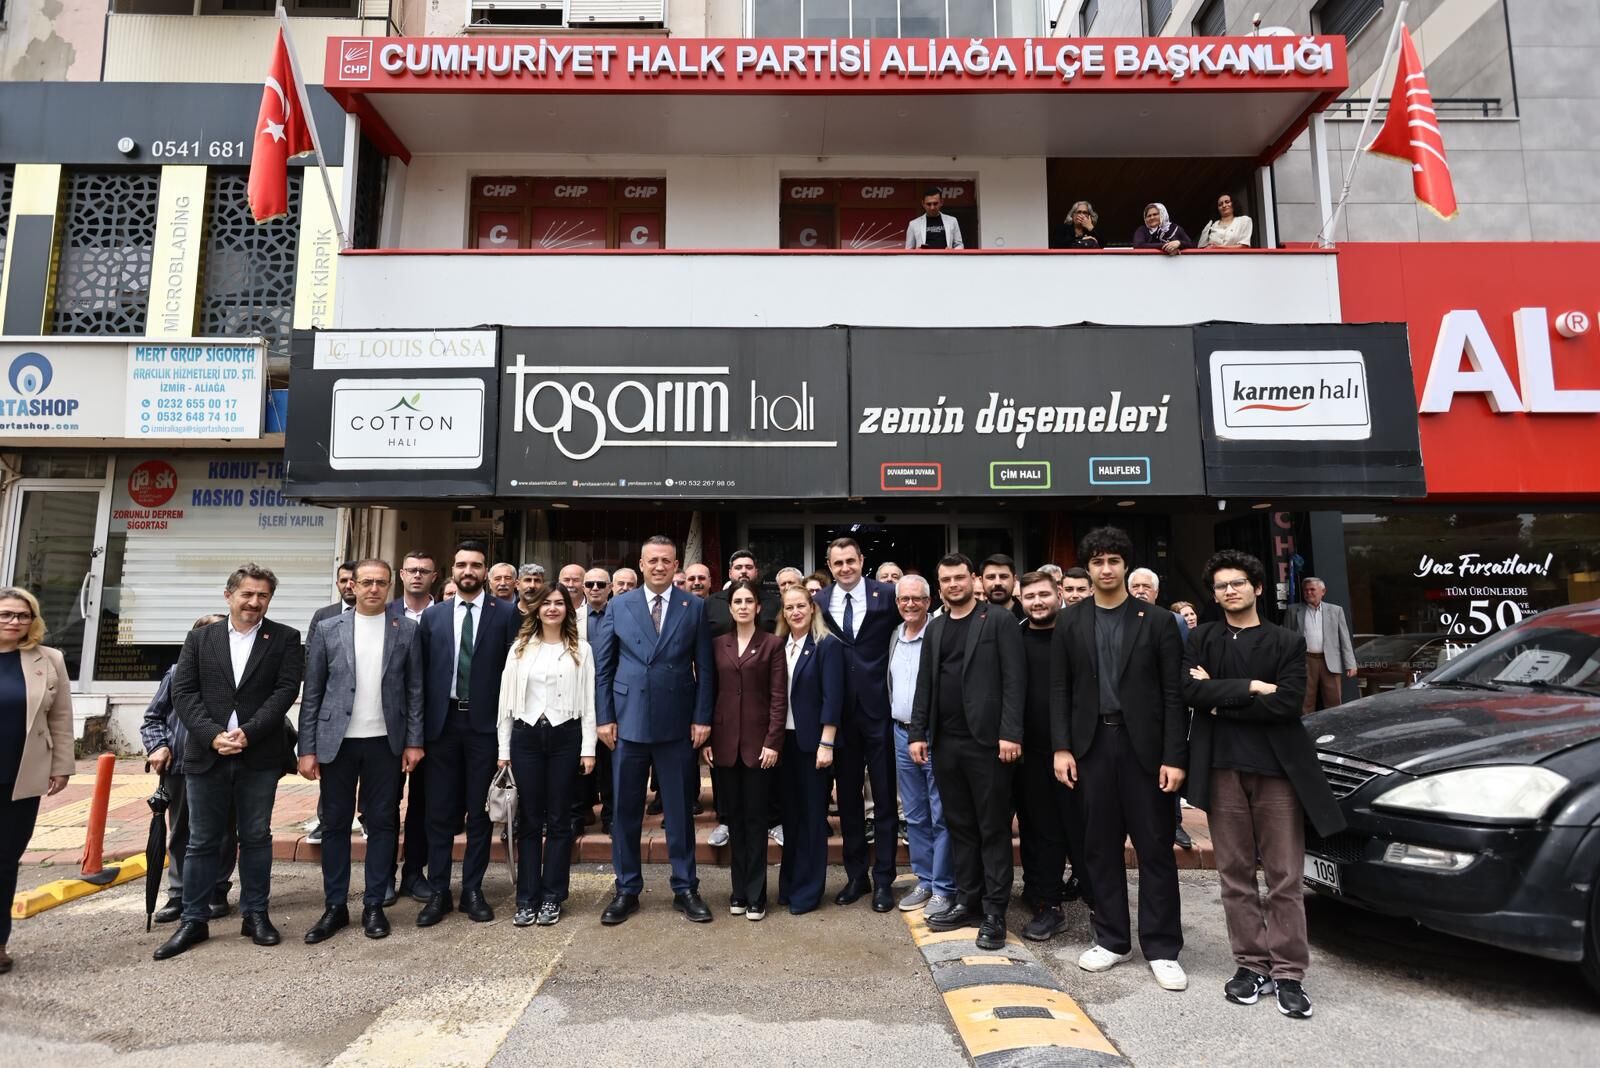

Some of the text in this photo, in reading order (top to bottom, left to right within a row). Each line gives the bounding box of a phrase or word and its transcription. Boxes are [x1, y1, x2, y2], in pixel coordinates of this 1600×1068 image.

[379, 37, 1333, 80] CUMHURİYET HALK PARTİSİ ALİAĞA İLÇE BAŞKANLIĞI
[343, 64, 367, 74] CHP
[151, 140, 244, 157] 0541 681
[483, 185, 517, 197] CHP
[554, 185, 588, 198] CHP
[624, 186, 657, 198] CHP
[791, 186, 825, 199] CHP
[861, 186, 895, 199] CHP
[939, 187, 964, 199] HP
[489, 225, 508, 244] C
[630, 226, 649, 245] C
[162, 195, 190, 332] MİCROBLADİNG
[311, 229, 332, 290] KİRPİK
[135, 344, 255, 363] MERT GRUP SİGORTA
[360, 338, 423, 358] LOUIS
[428, 338, 486, 358] CASA
[133, 367, 171, 380] ARACILIK
[173, 366, 221, 380] HİZMETLERİ
[223, 368, 240, 379] LTD.
[160, 381, 186, 392] İZMİR
[195, 381, 226, 393] ALİAĞA
[1233, 378, 1359, 401] karmen halı
[157, 398, 237, 409] 0232 655 00 17
[157, 411, 237, 422] 0532 648 74 10
[350, 415, 453, 431] COTTON
[858, 391, 1170, 449] zemin döşemeleri
[388, 438, 417, 447] HALI
[887, 468, 936, 476] DUVARDAN DUVARA
[1000, 469, 1041, 480] ÇİM HALI
[1098, 465, 1141, 476] HALIFLEKS
[905, 478, 917, 486] HALI
[191, 489, 244, 507] KASKO
[113, 510, 183, 519] ZORUNLU DEPREM
[258, 513, 324, 529] İŞLERİ YAPILIR
[127, 519, 168, 530] SİGORTASI
[1414, 552, 1553, 577] Yaz Fırsatları!
[1445, 586, 1528, 596] TÜM ÜRÜNLERDE
[1313, 859, 1336, 883] 109
